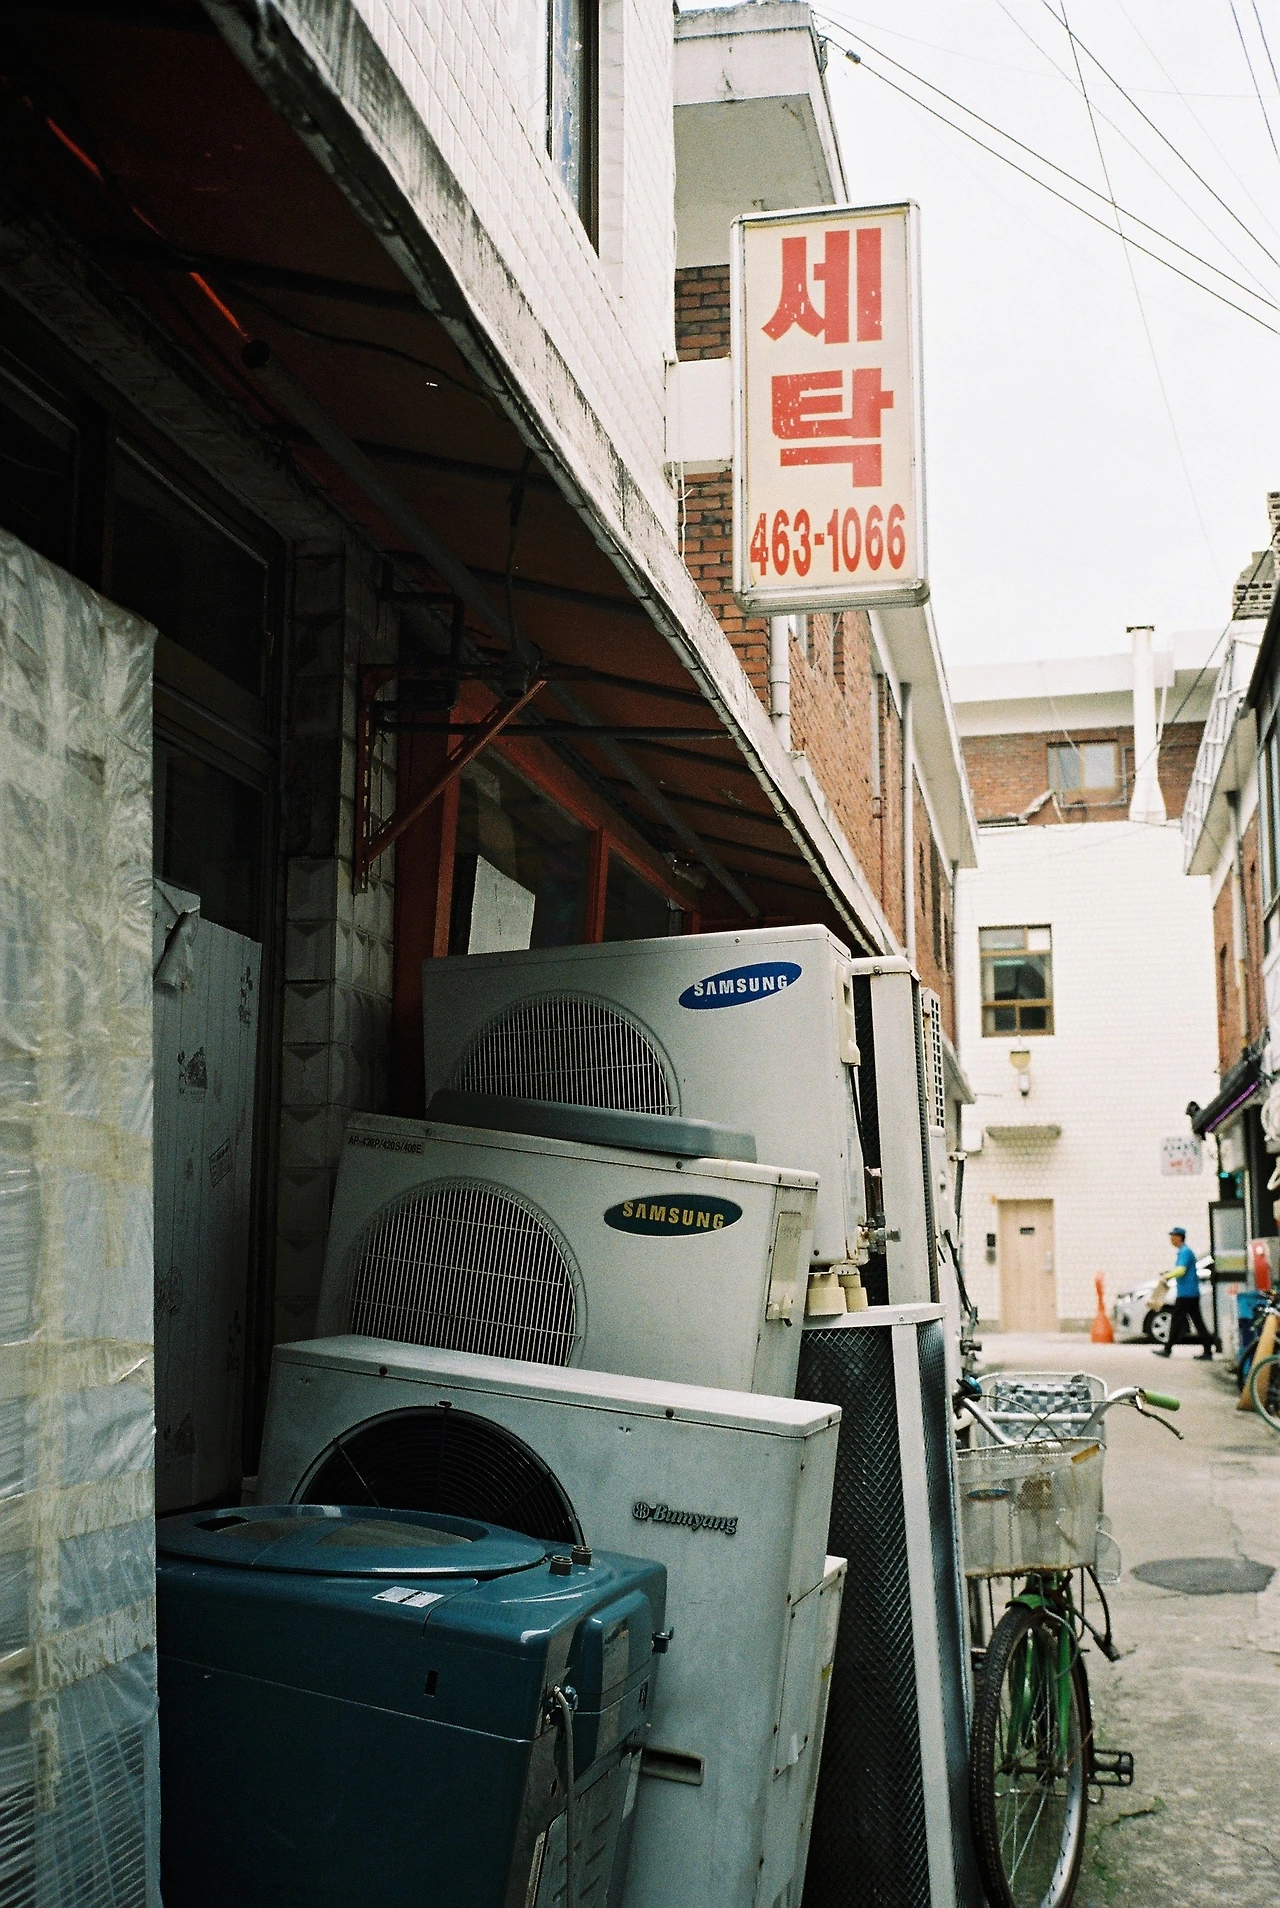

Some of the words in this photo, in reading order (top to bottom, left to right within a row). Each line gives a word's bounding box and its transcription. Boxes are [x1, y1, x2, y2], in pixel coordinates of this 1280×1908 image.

[761, 227, 894, 488] 세탁
[750, 503, 906, 577] 463-1066
[693, 974, 788, 997] SAMSUNG
[622, 1200, 725, 1230] SAMSUNG
[652, 1503, 738, 1535] Bumyang
